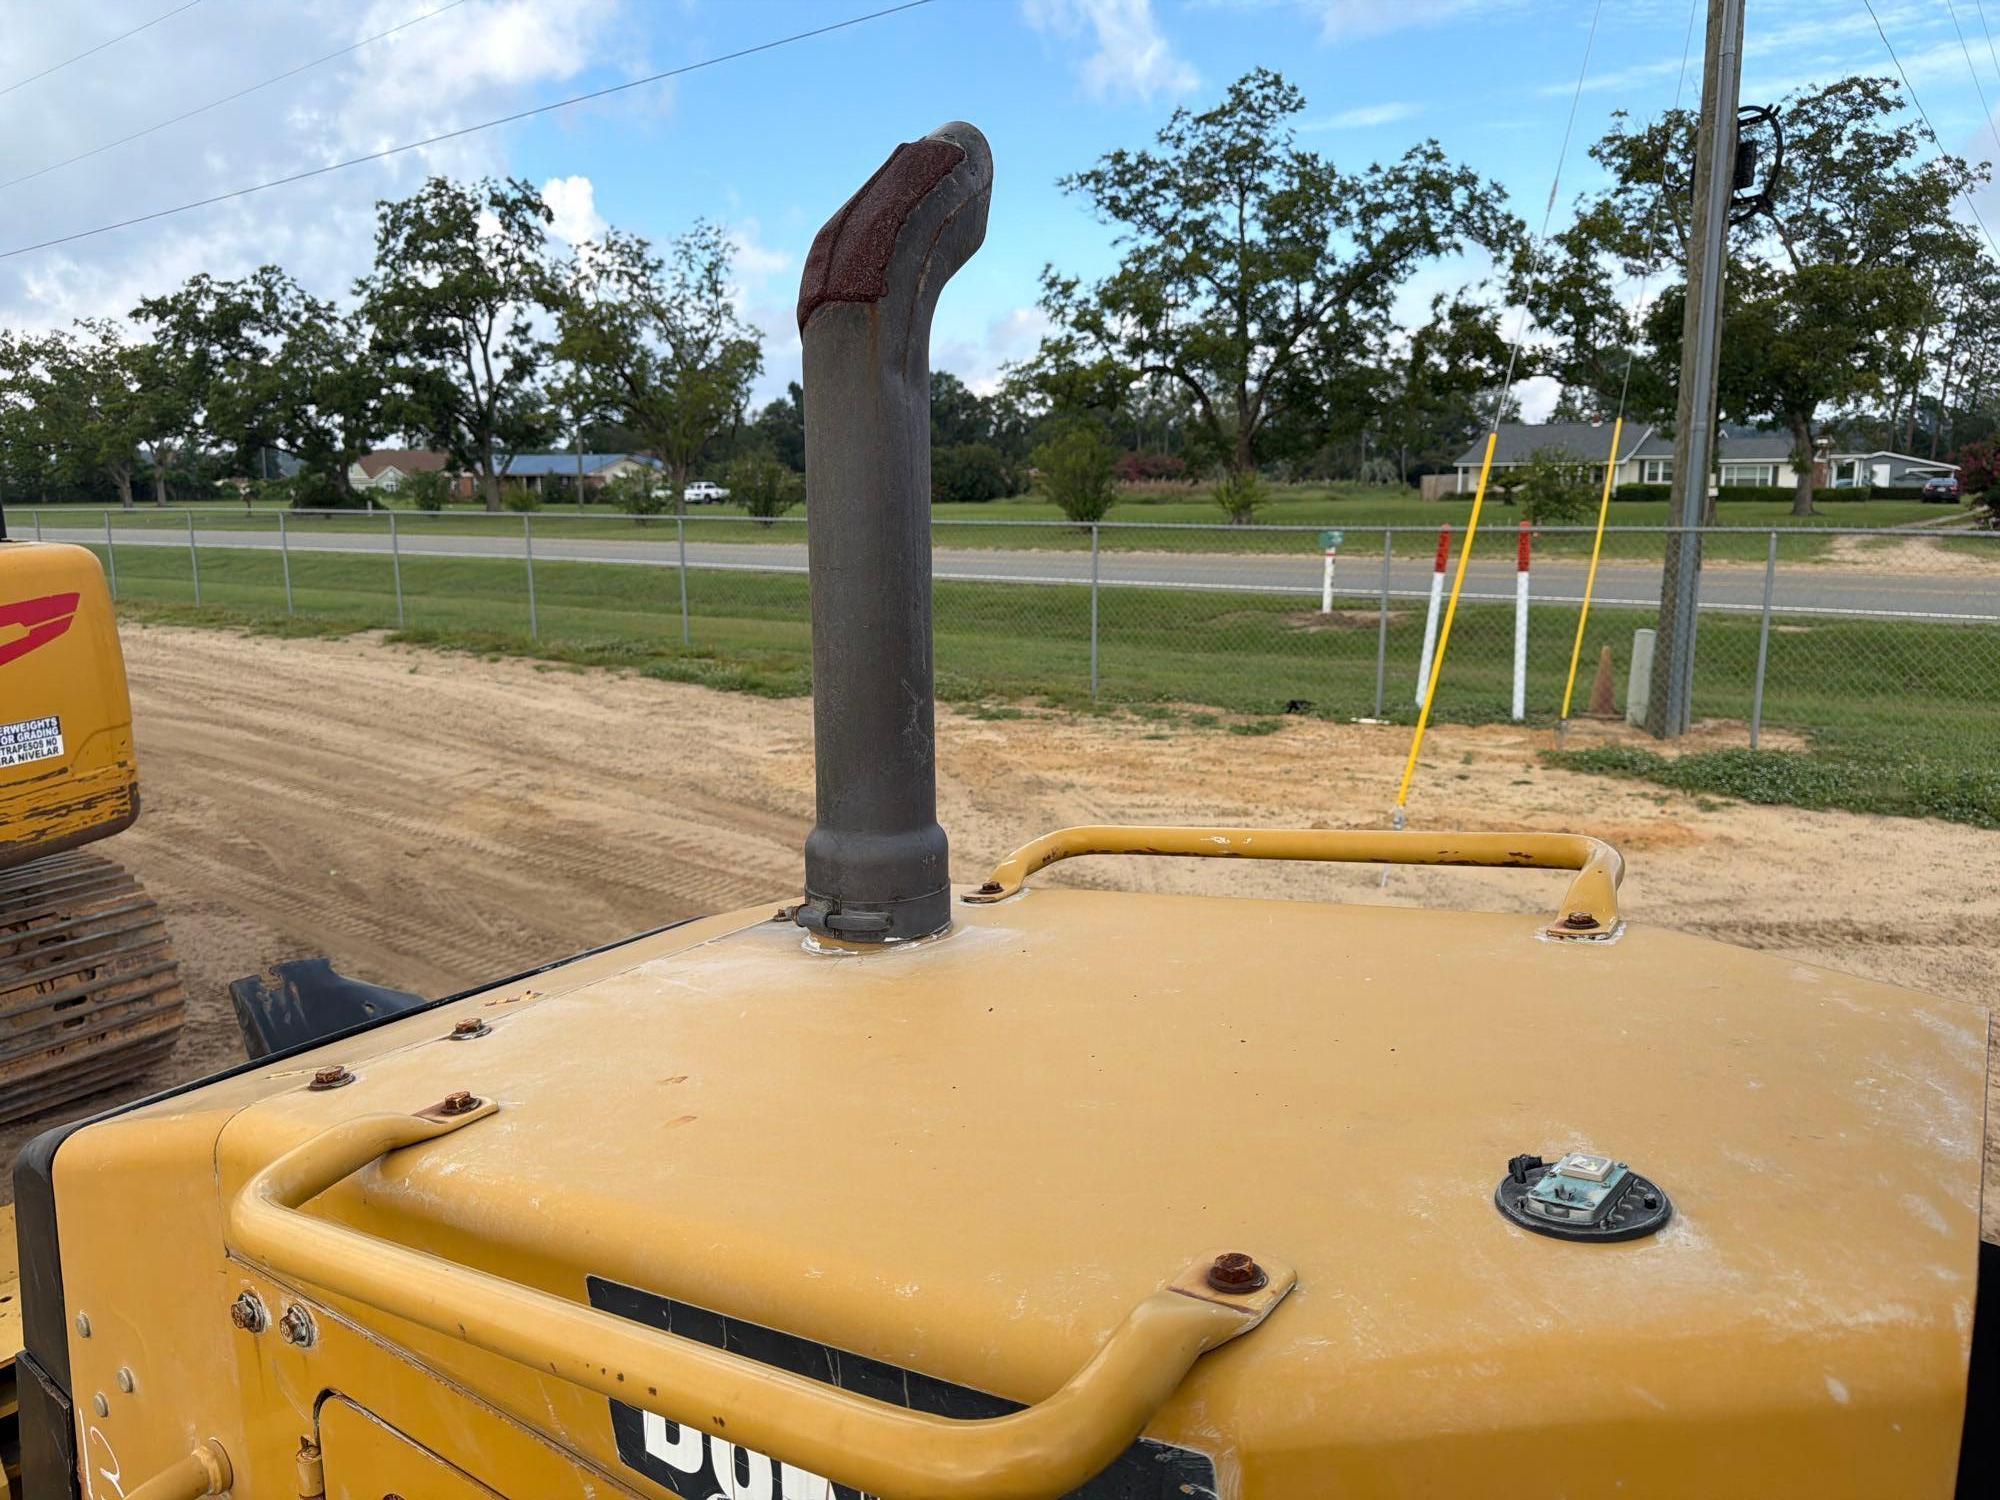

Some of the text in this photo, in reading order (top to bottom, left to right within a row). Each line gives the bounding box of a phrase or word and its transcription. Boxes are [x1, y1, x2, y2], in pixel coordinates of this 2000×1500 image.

[16, 726, 59, 742] GRADING
[0, 737, 57, 756] TRAPESOS NO
[0, 746, 59, 766] RA NIVELAR
